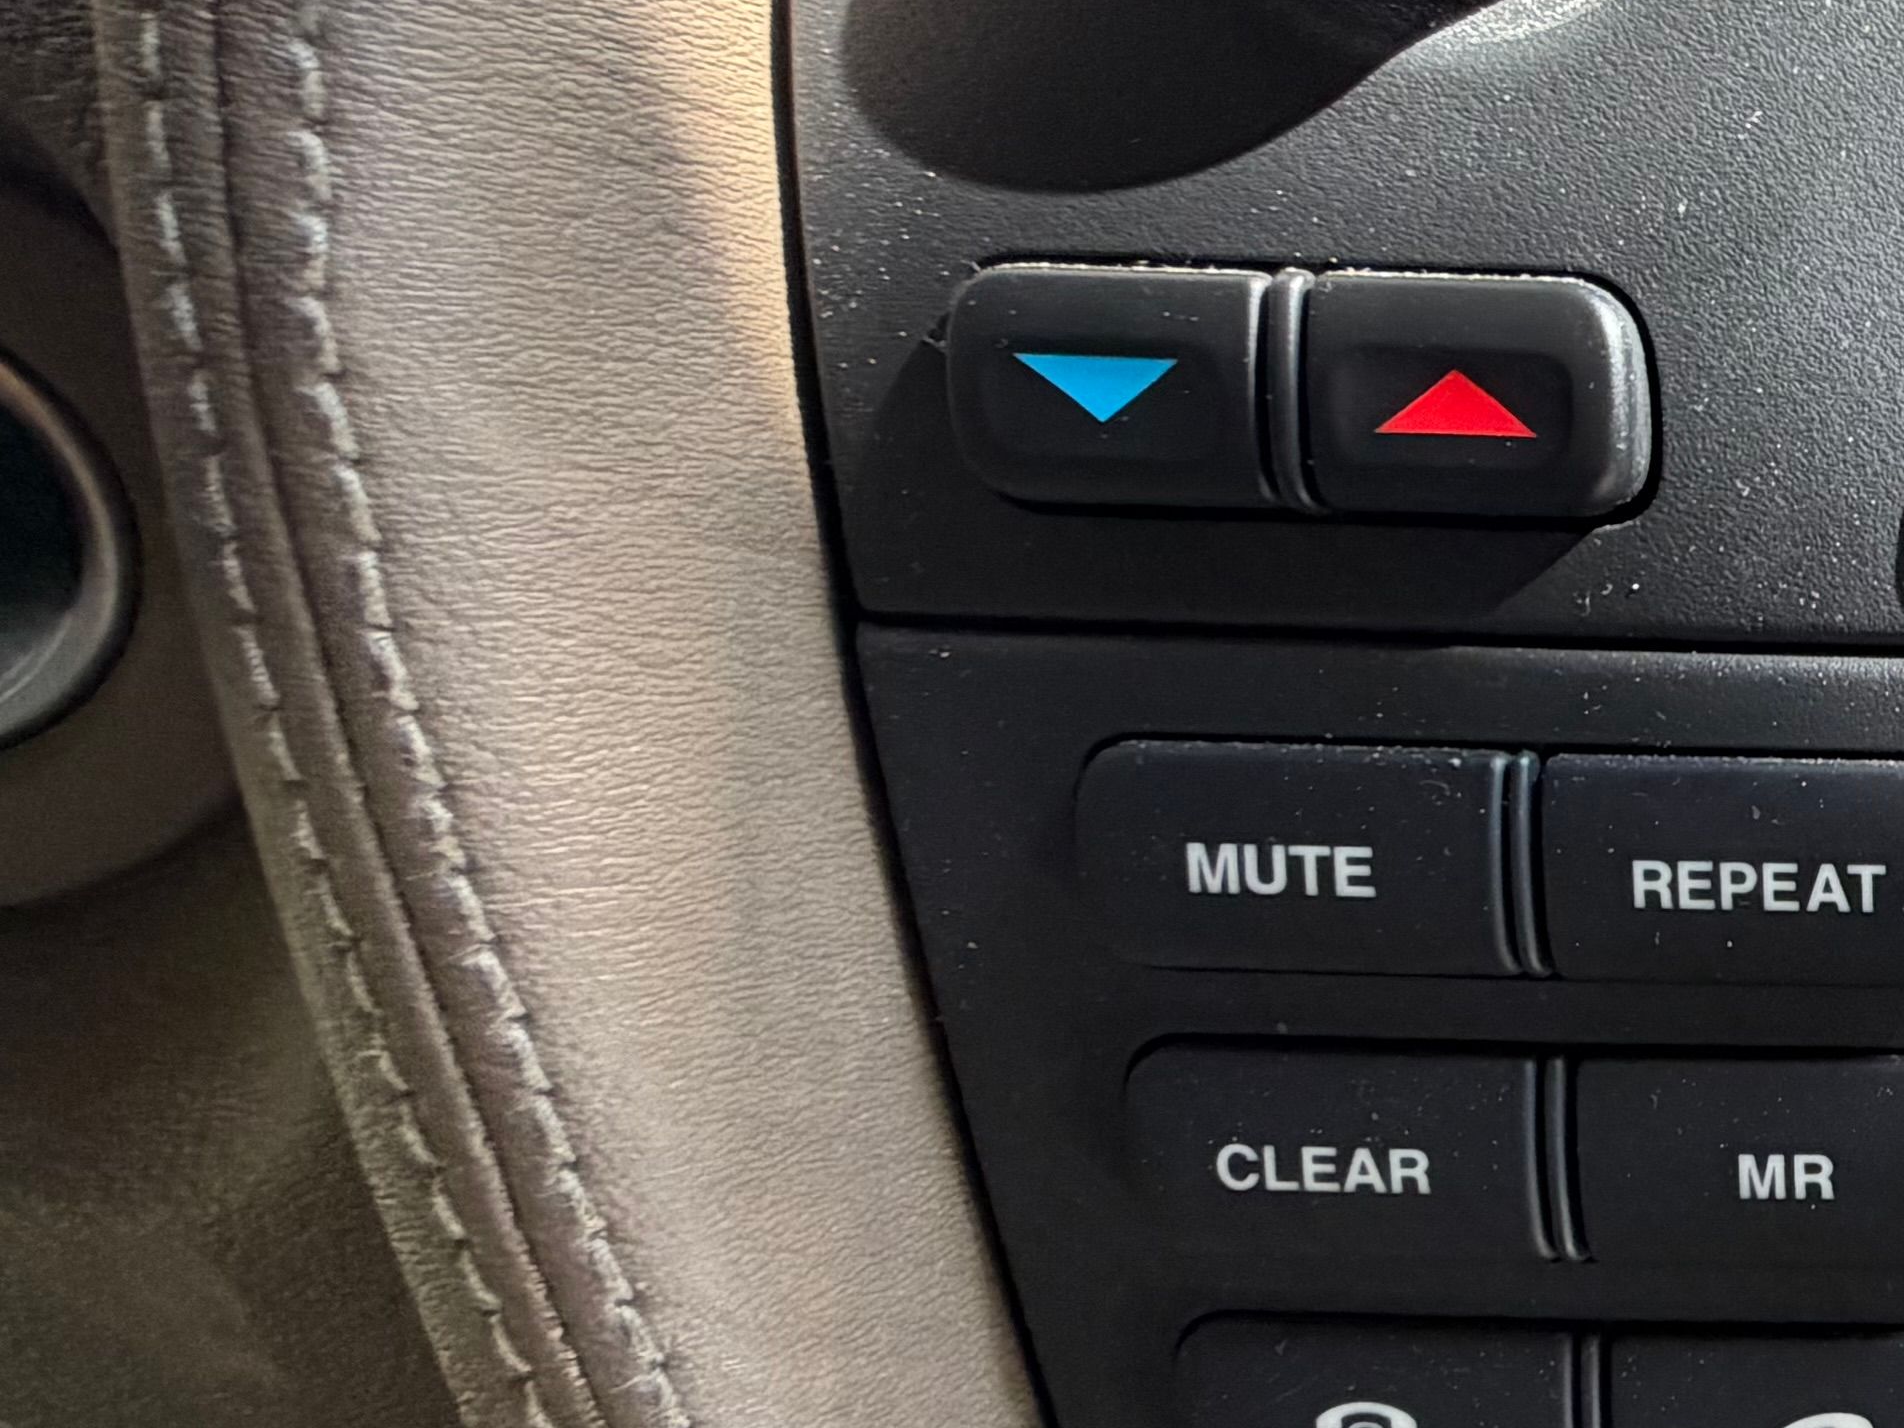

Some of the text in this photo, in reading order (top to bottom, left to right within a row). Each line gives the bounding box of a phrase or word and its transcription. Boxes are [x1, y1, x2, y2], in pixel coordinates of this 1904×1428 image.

[1185, 841, 1377, 899] MUTE
[1631, 858, 1887, 914] REPEAT
[1215, 1142, 1431, 1196] CLEAR
[1736, 1152, 1836, 1200] MR
